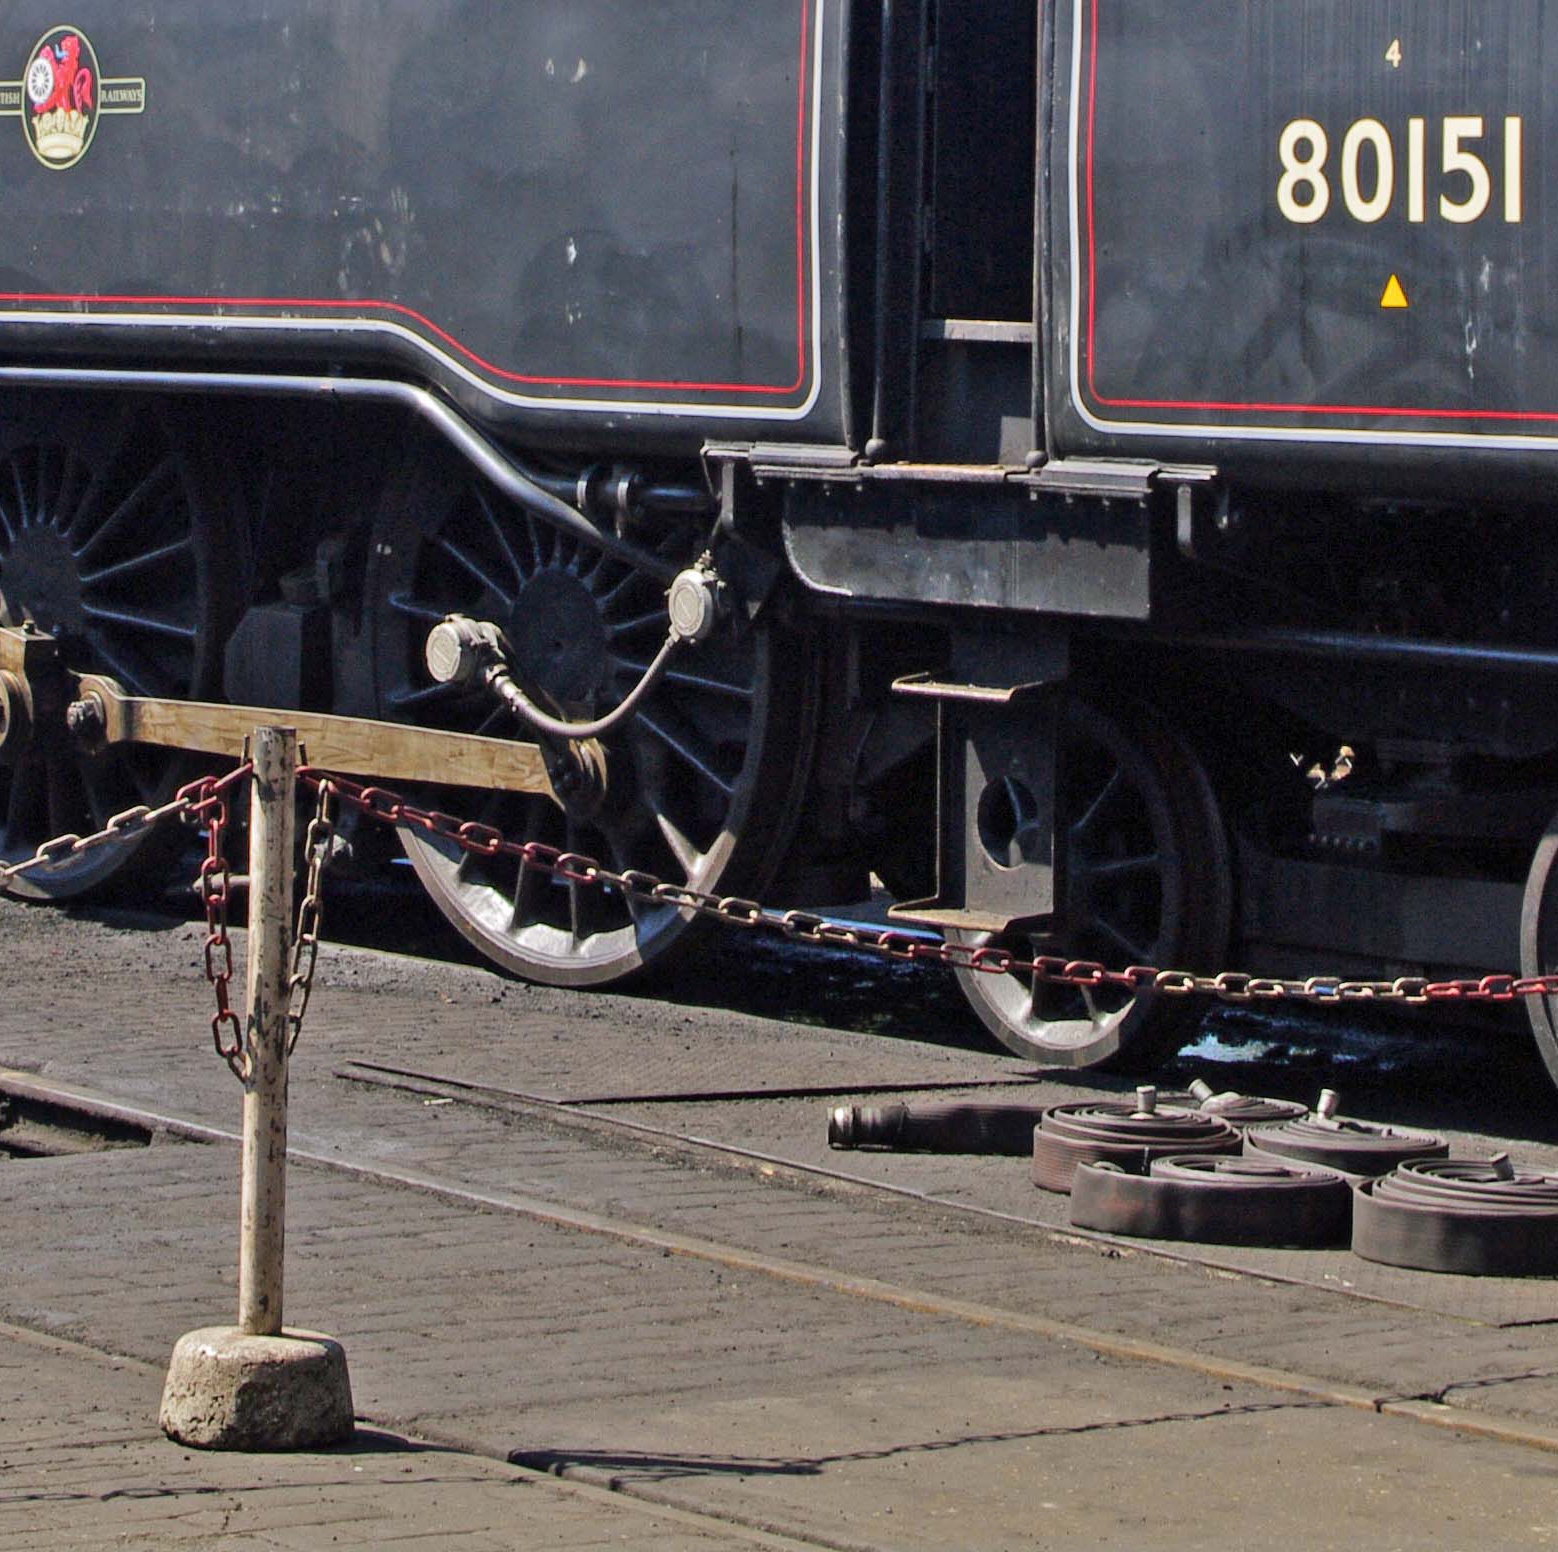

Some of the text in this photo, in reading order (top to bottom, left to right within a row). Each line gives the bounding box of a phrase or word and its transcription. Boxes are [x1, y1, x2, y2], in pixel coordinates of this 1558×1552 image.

[1385, 38, 1402, 68] 4
[101, 88, 142, 103] RAILWAYS
[1276, 115, 1523, 224] 80151
